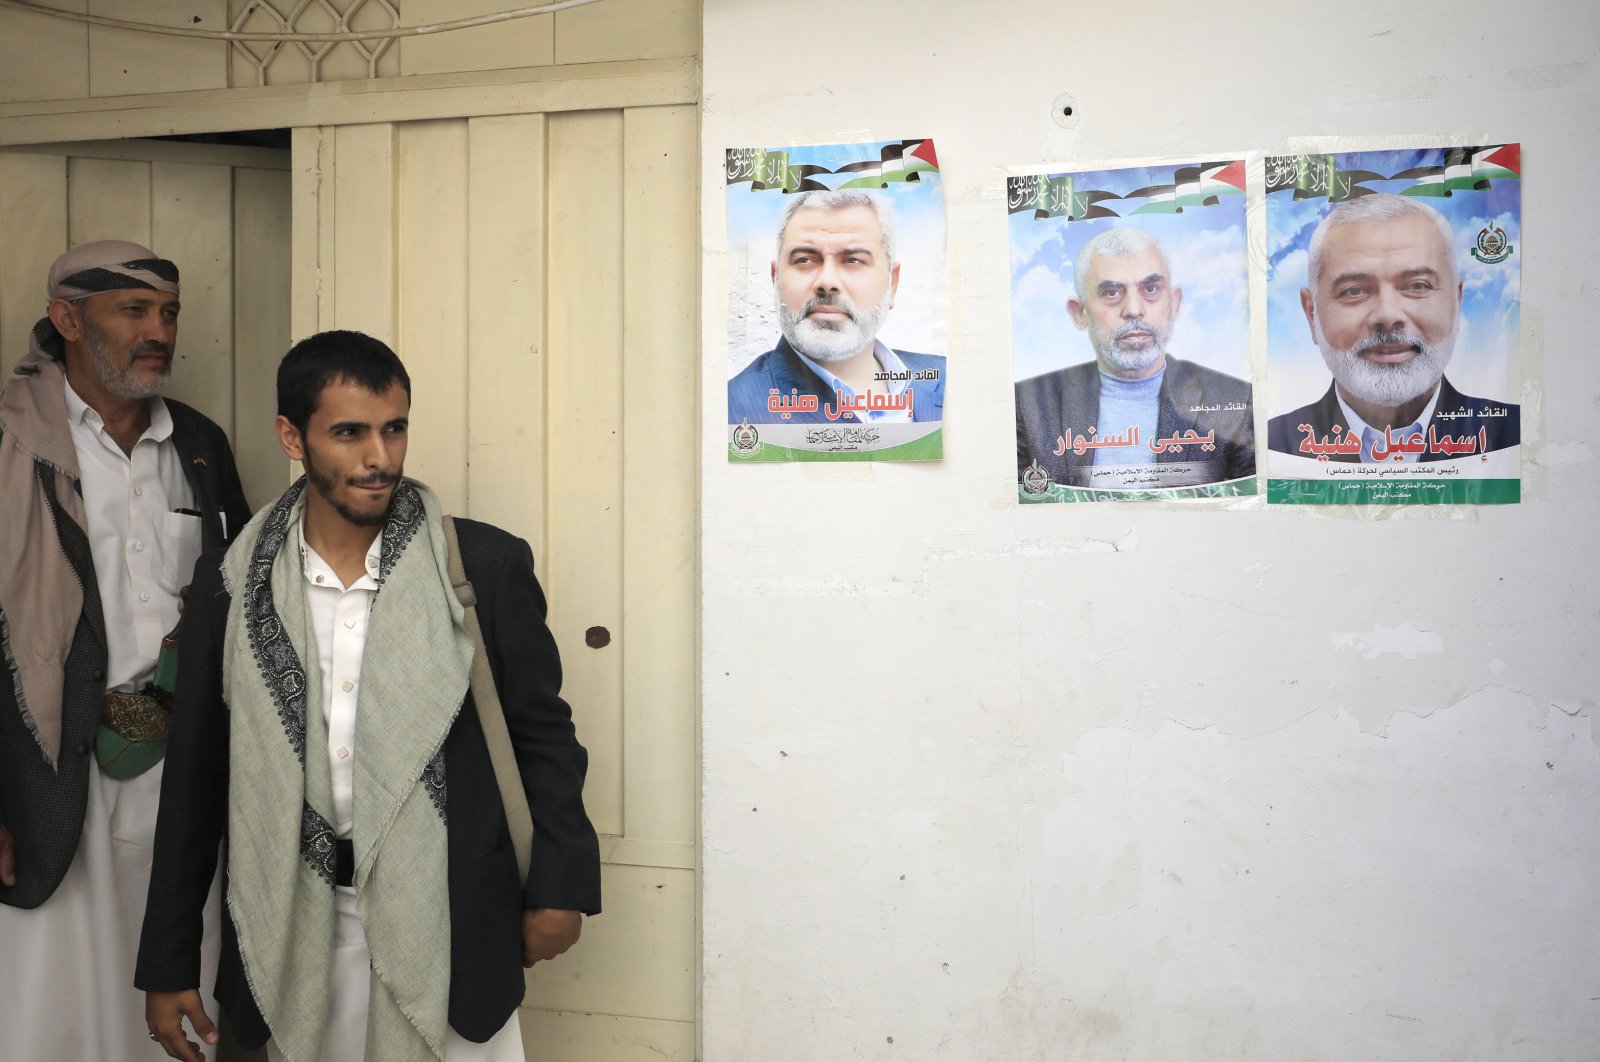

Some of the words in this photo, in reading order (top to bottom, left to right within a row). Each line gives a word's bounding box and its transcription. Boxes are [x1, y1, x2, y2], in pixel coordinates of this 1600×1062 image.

[873, 370, 912, 383] المجاهد
[915, 369, 939, 380] القائد
[768, 388, 819, 419] هنية
[824, 387, 914, 420] إسماعيل
[1189, 404, 1221, 413] المجاهد
[1223, 401, 1247, 411] القائد
[1436, 407, 1473, 420] الشهيد
[1477, 407, 1508, 418] القائد
[1053, 425, 1140, 456] السنوار
[1148, 427, 1216, 454] يحيى
[1297, 423, 1363, 462] هنية
[1370, 424, 1489, 464] إسماعيل
[1379, 467, 1409, 477] السياسي
[1411, 467, 1435, 475] المكتب
[1437, 466, 1459, 476] رئيس
[1395, 482, 1421, 490] المقاومة
